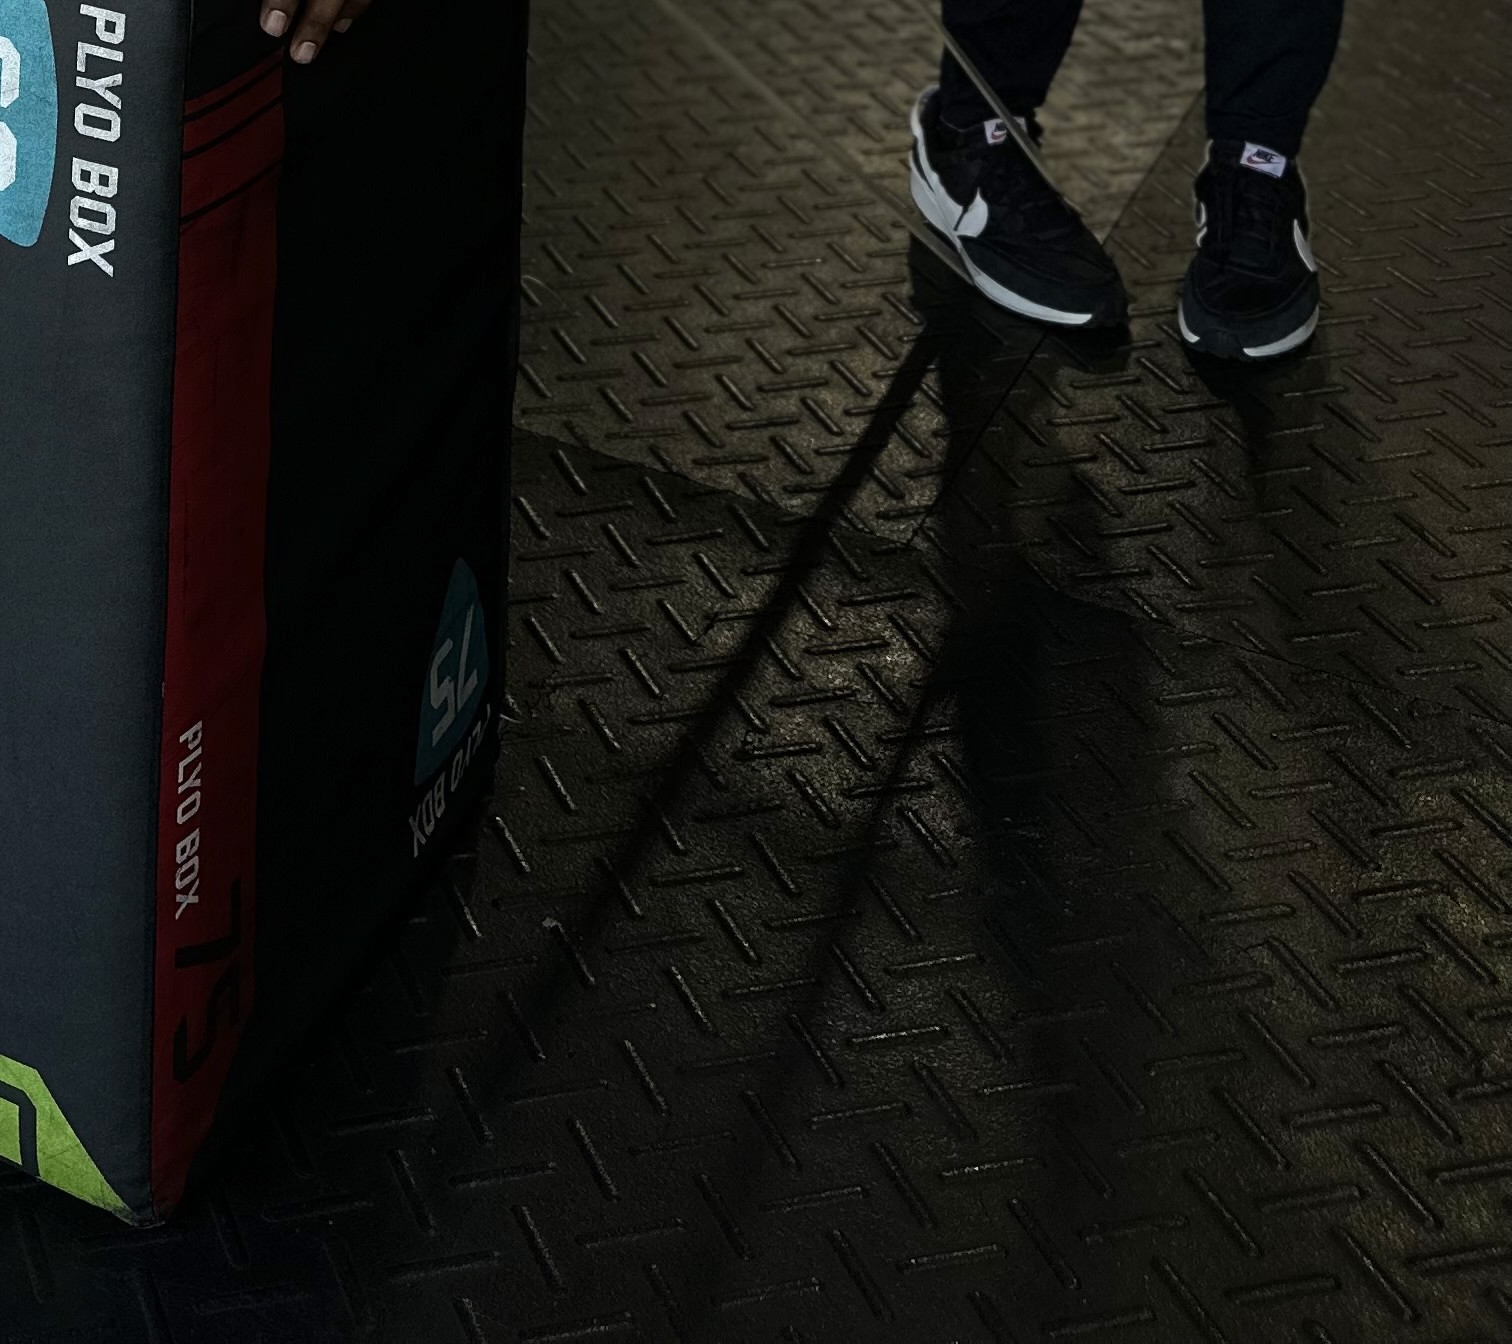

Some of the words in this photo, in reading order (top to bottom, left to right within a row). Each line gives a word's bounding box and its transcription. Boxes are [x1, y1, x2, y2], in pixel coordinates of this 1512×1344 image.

[73, 3, 126, 142] PLYO
[67, 156, 119, 277] BOX
[176, 720, 203, 825] PLYO
[174, 827, 201, 920] BOX
